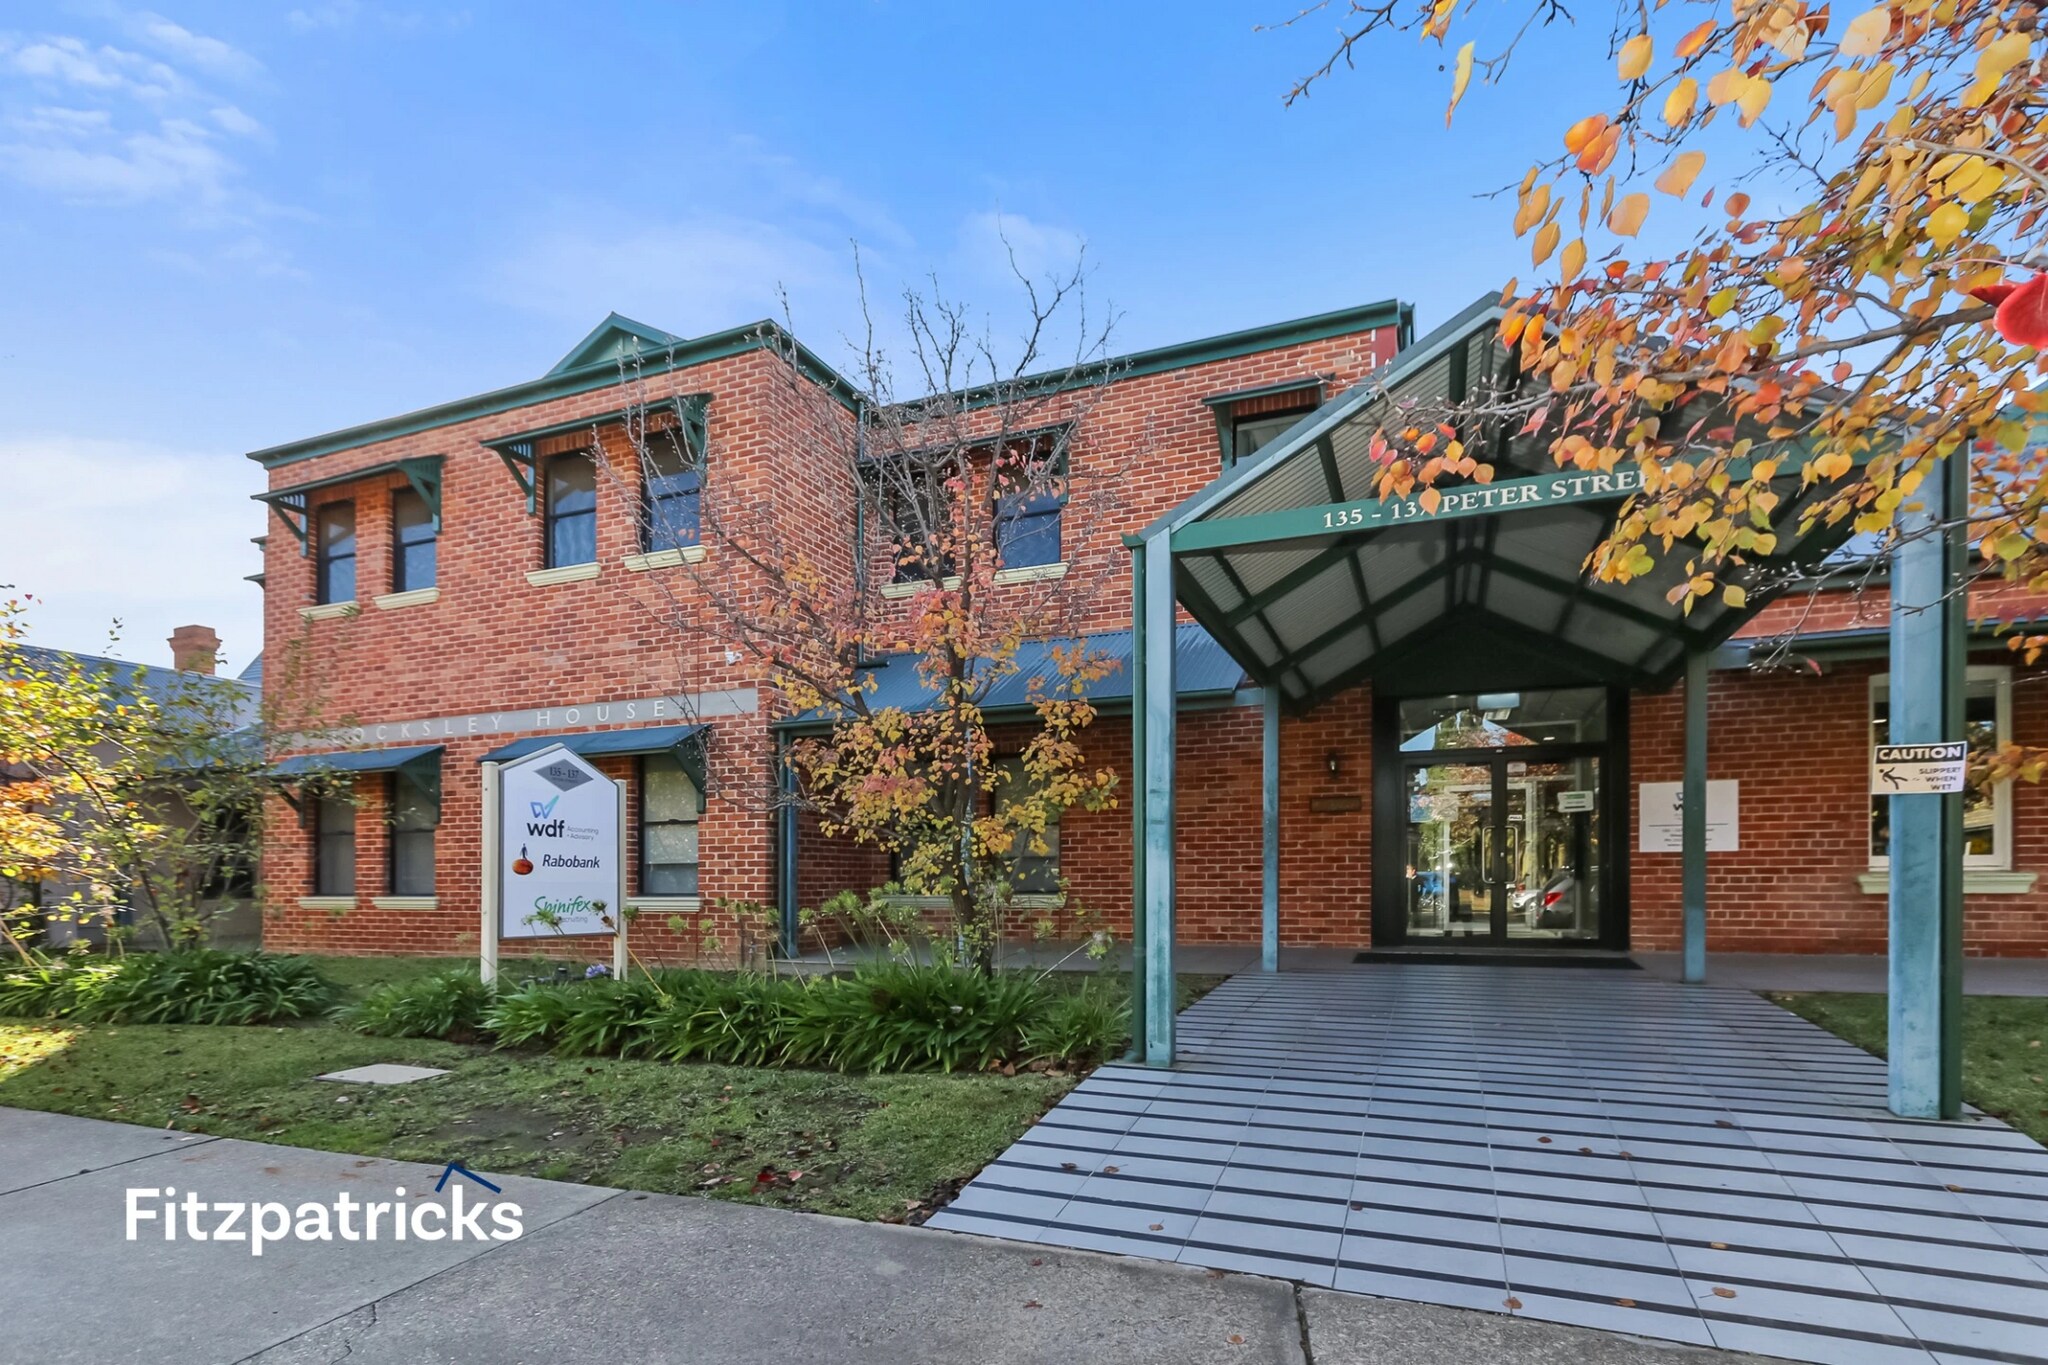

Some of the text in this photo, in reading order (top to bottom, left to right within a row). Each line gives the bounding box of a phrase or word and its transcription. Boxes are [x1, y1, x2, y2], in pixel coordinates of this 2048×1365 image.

[1323, 508, 1363, 528] 135
[1391, 501, 1426, 520] 13
[1441, 484, 1542, 513] PETER
[331, 700, 665, 744] OCKSLEY HOUSE
[1879, 746, 1961, 760] CAUTION
[549, 766, 561, 776] 135
[567, 769, 579, 778] 137
[527, 819, 565, 838] wdf
[566, 826, 599, 836] Accounting
[542, 854, 600, 869] Rabobank
